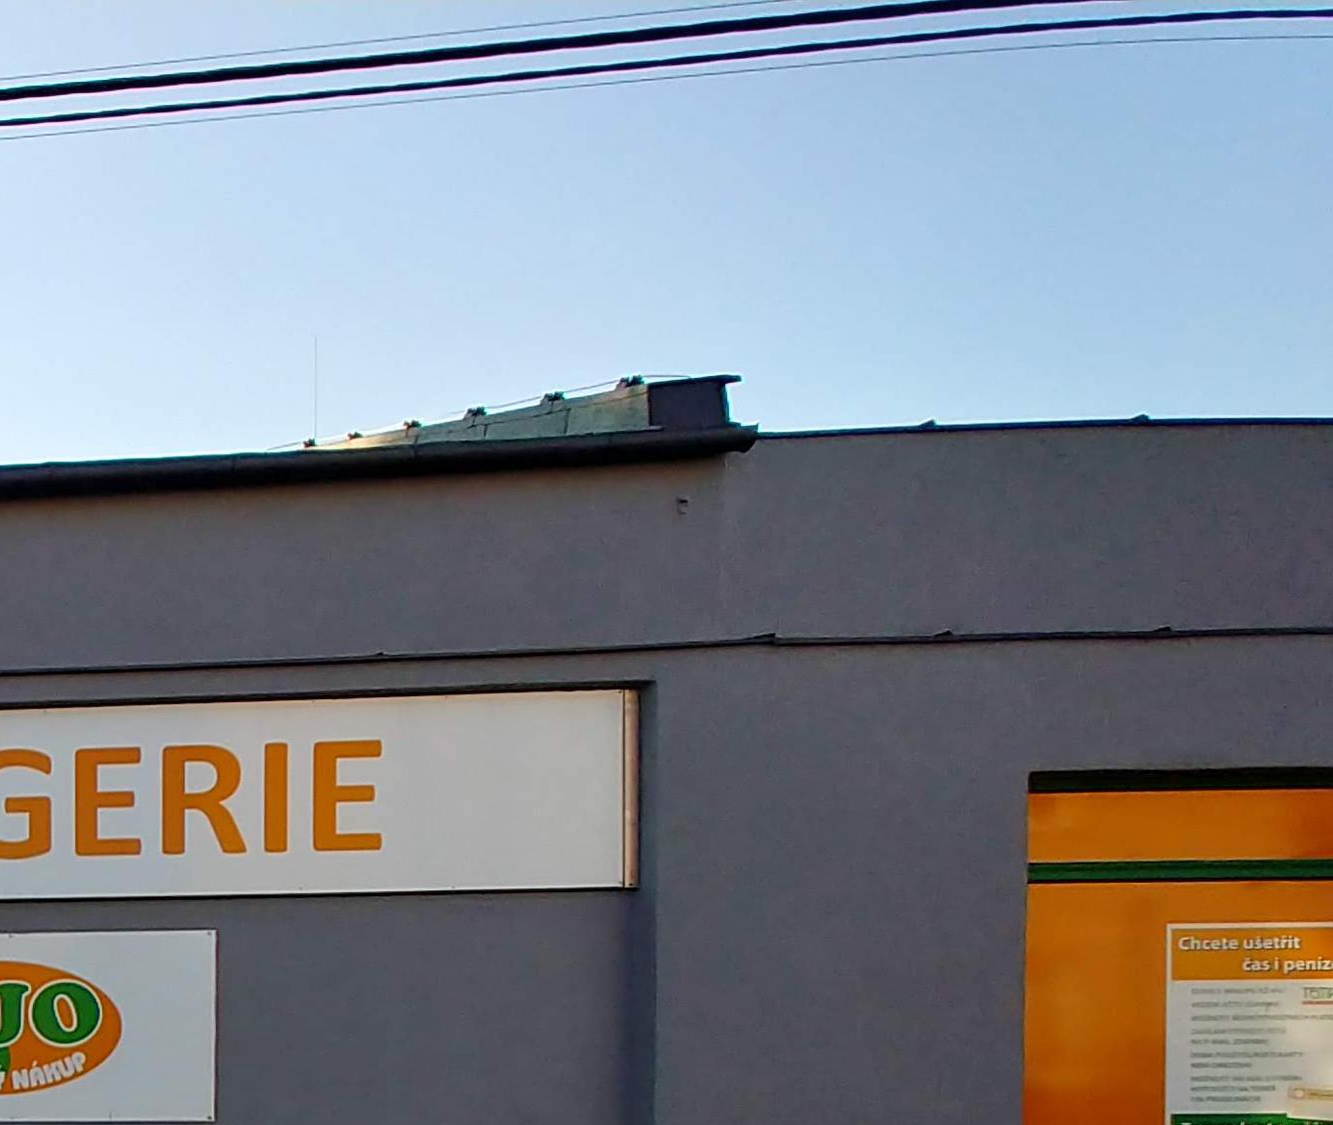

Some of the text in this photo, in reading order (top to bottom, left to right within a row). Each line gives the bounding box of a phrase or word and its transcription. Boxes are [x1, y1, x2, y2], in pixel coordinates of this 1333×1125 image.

[1178, 935, 1301, 950] Chcete ušetřit
[1242, 957, 1270, 971] čas
[1275, 956, 1279, 970] i
[12, 1051, 86, 1090] NÁKUP
